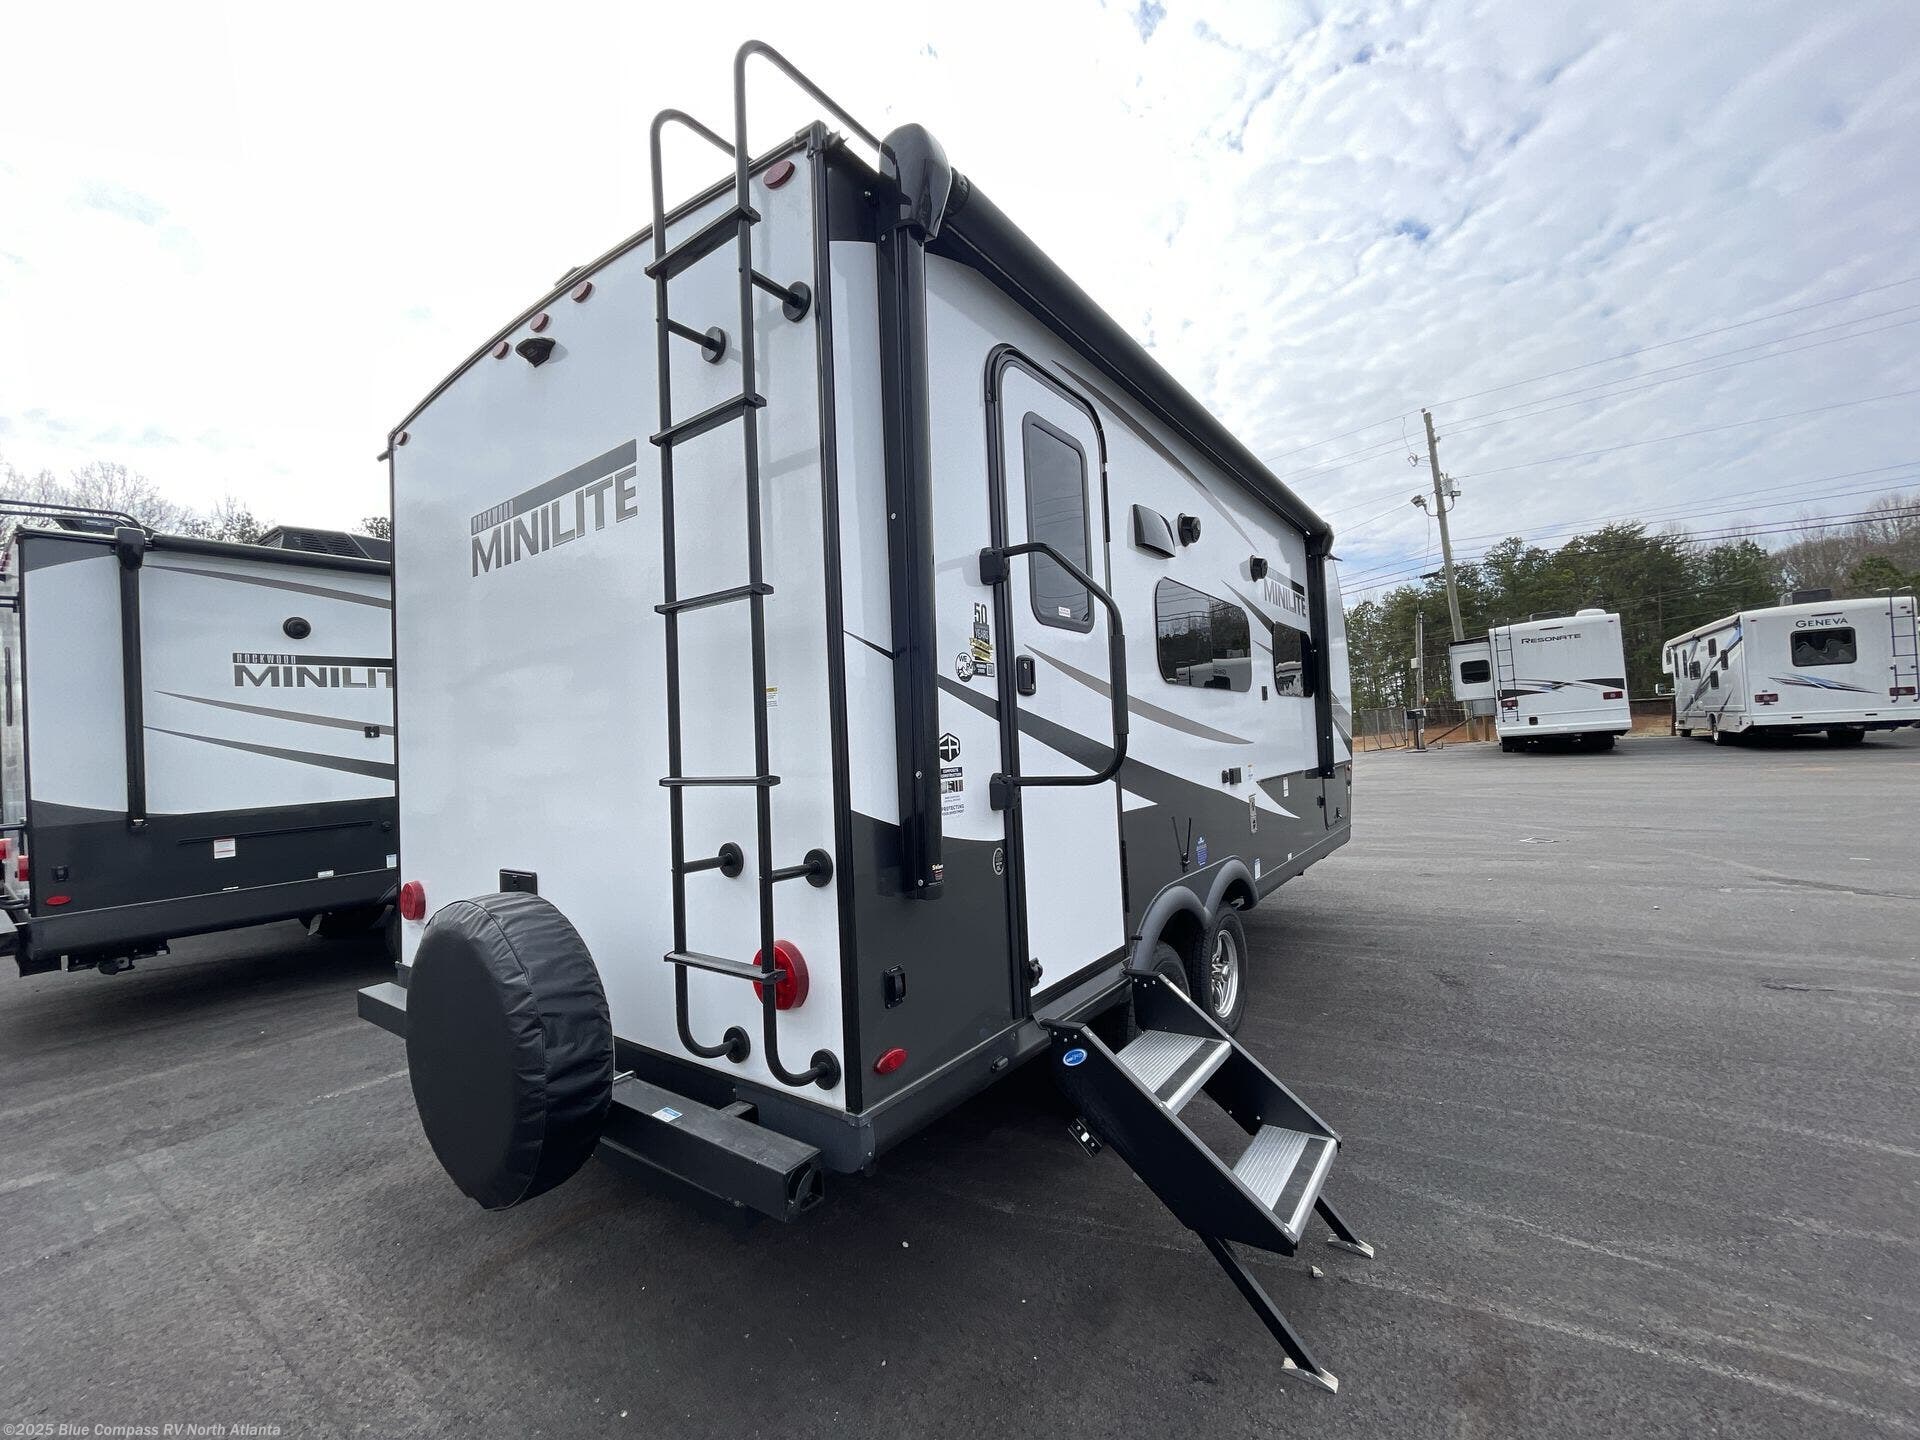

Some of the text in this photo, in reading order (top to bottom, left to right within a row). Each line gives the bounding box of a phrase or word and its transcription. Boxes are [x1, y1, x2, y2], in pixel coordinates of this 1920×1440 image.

[471, 465, 638, 577] MINILITE
[1264, 579, 1306, 617] MINILITE
[974, 602, 987, 624] 50
[1795, 617, 1848, 628] GENEVA
[1521, 634, 1581, 644] RESONATE
[236, 653, 296, 665] ROCKWOOD
